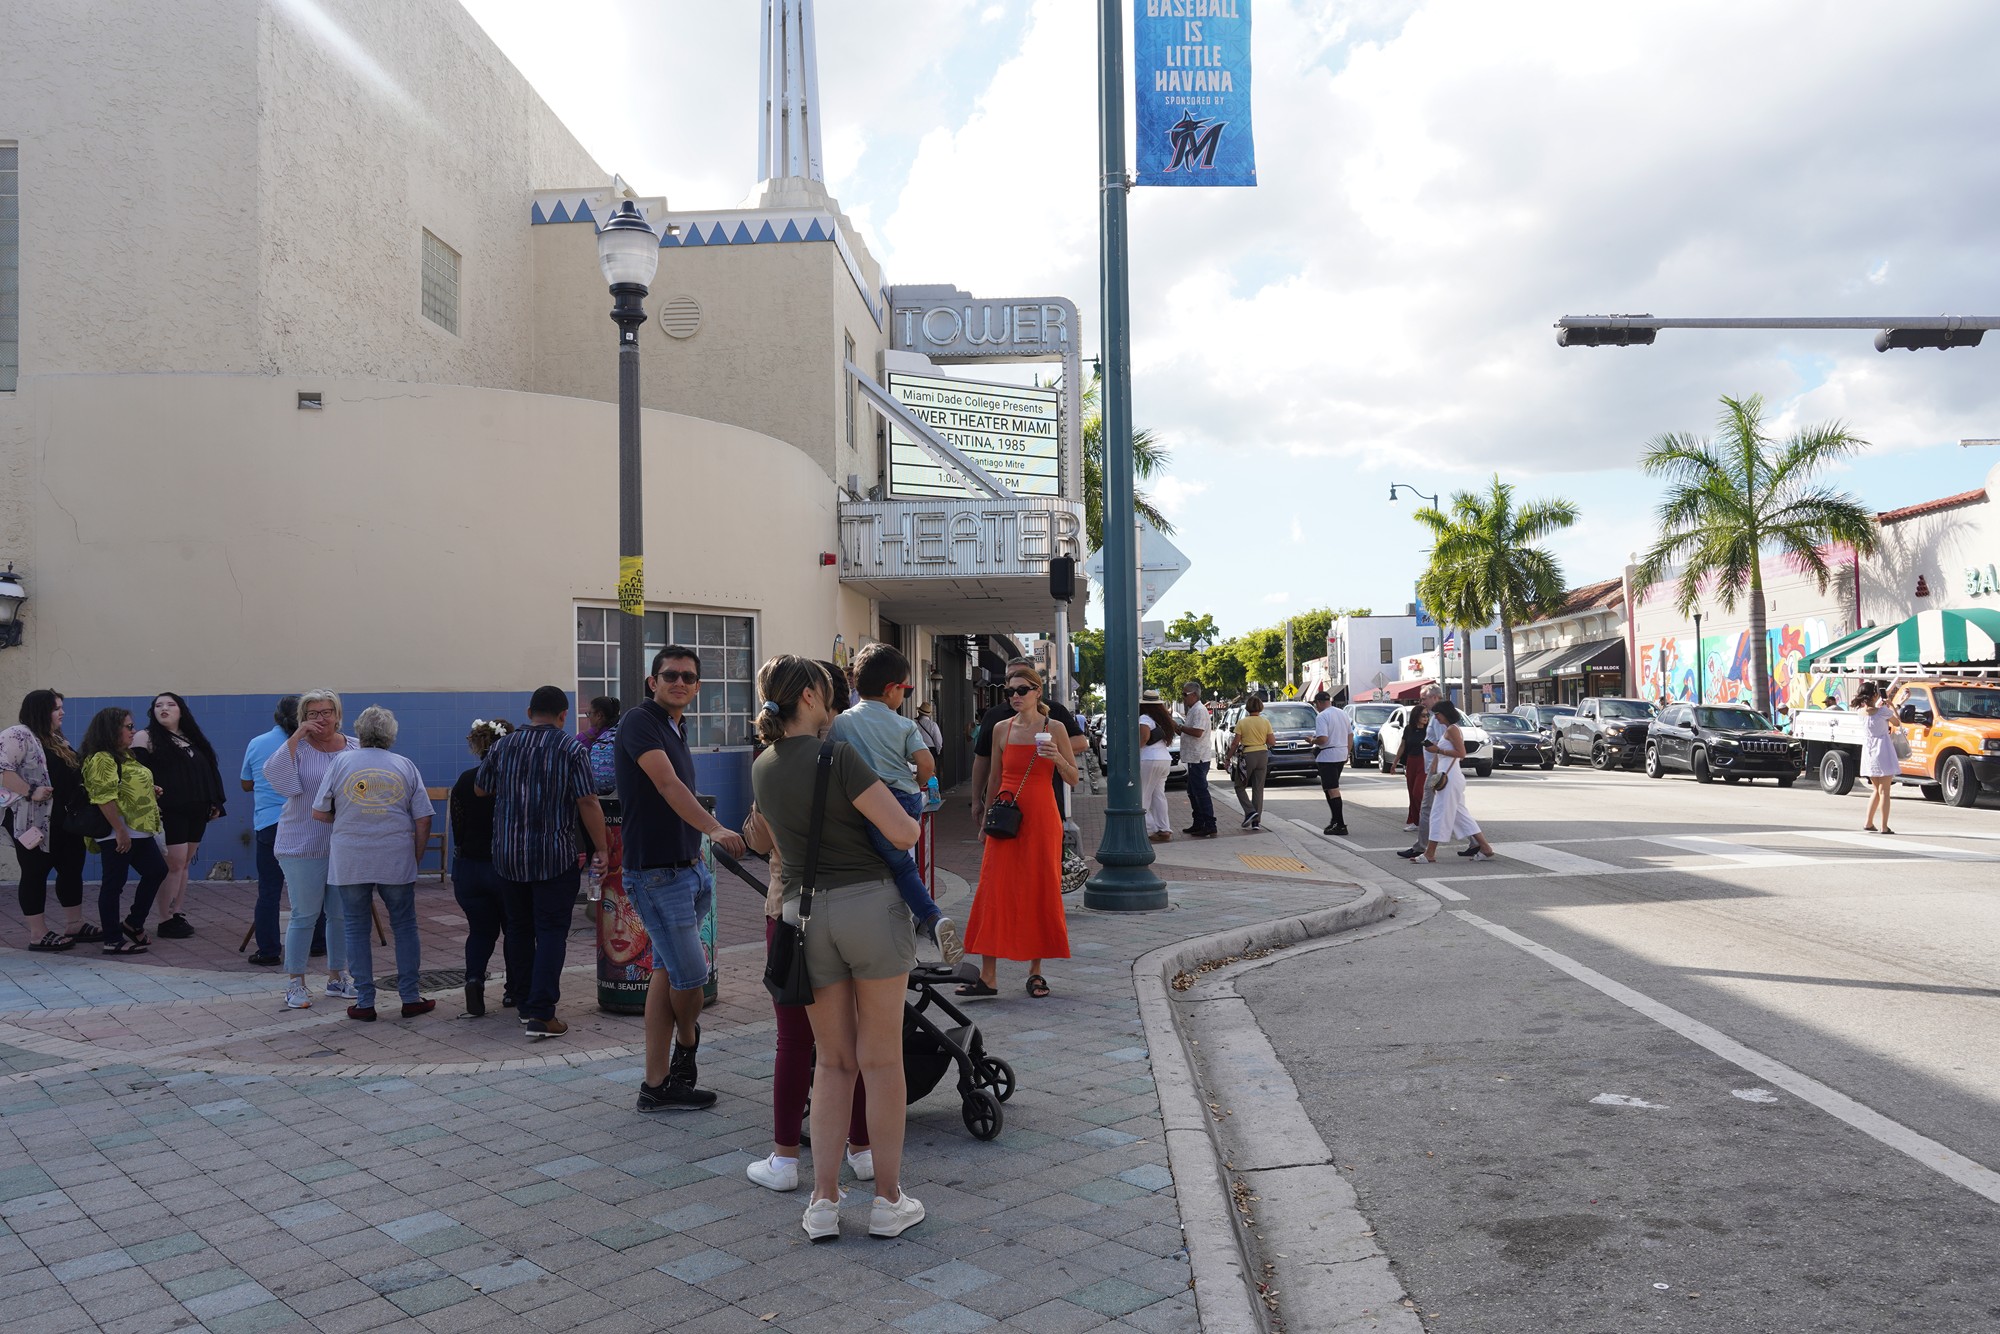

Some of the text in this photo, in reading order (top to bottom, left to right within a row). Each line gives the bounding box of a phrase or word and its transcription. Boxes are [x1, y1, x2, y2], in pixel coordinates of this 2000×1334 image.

[1147, 0, 1239, 18] BASEBALL
[1185, 21, 1203, 42] IS
[1166, 45, 1222, 67] LITTLE
[1155, 70, 1233, 92] HAVANA
[1165, 96, 1225, 105] SPONSORED BY
[896, 304, 1067, 346] TOWER
[903, 389, 1043, 414] Miami Dade College Presents
[950, 412, 1008, 431] THEATER
[1013, 418, 1051, 435] MIAMI
[998, 438, 1026, 451] 1985
[1005, 457, 1025, 470] Mitre
[1005, 478, 1020, 488] PM
[841, 509, 1081, 566] THEATER
[618, 983, 649, 991] BEAUTIF
